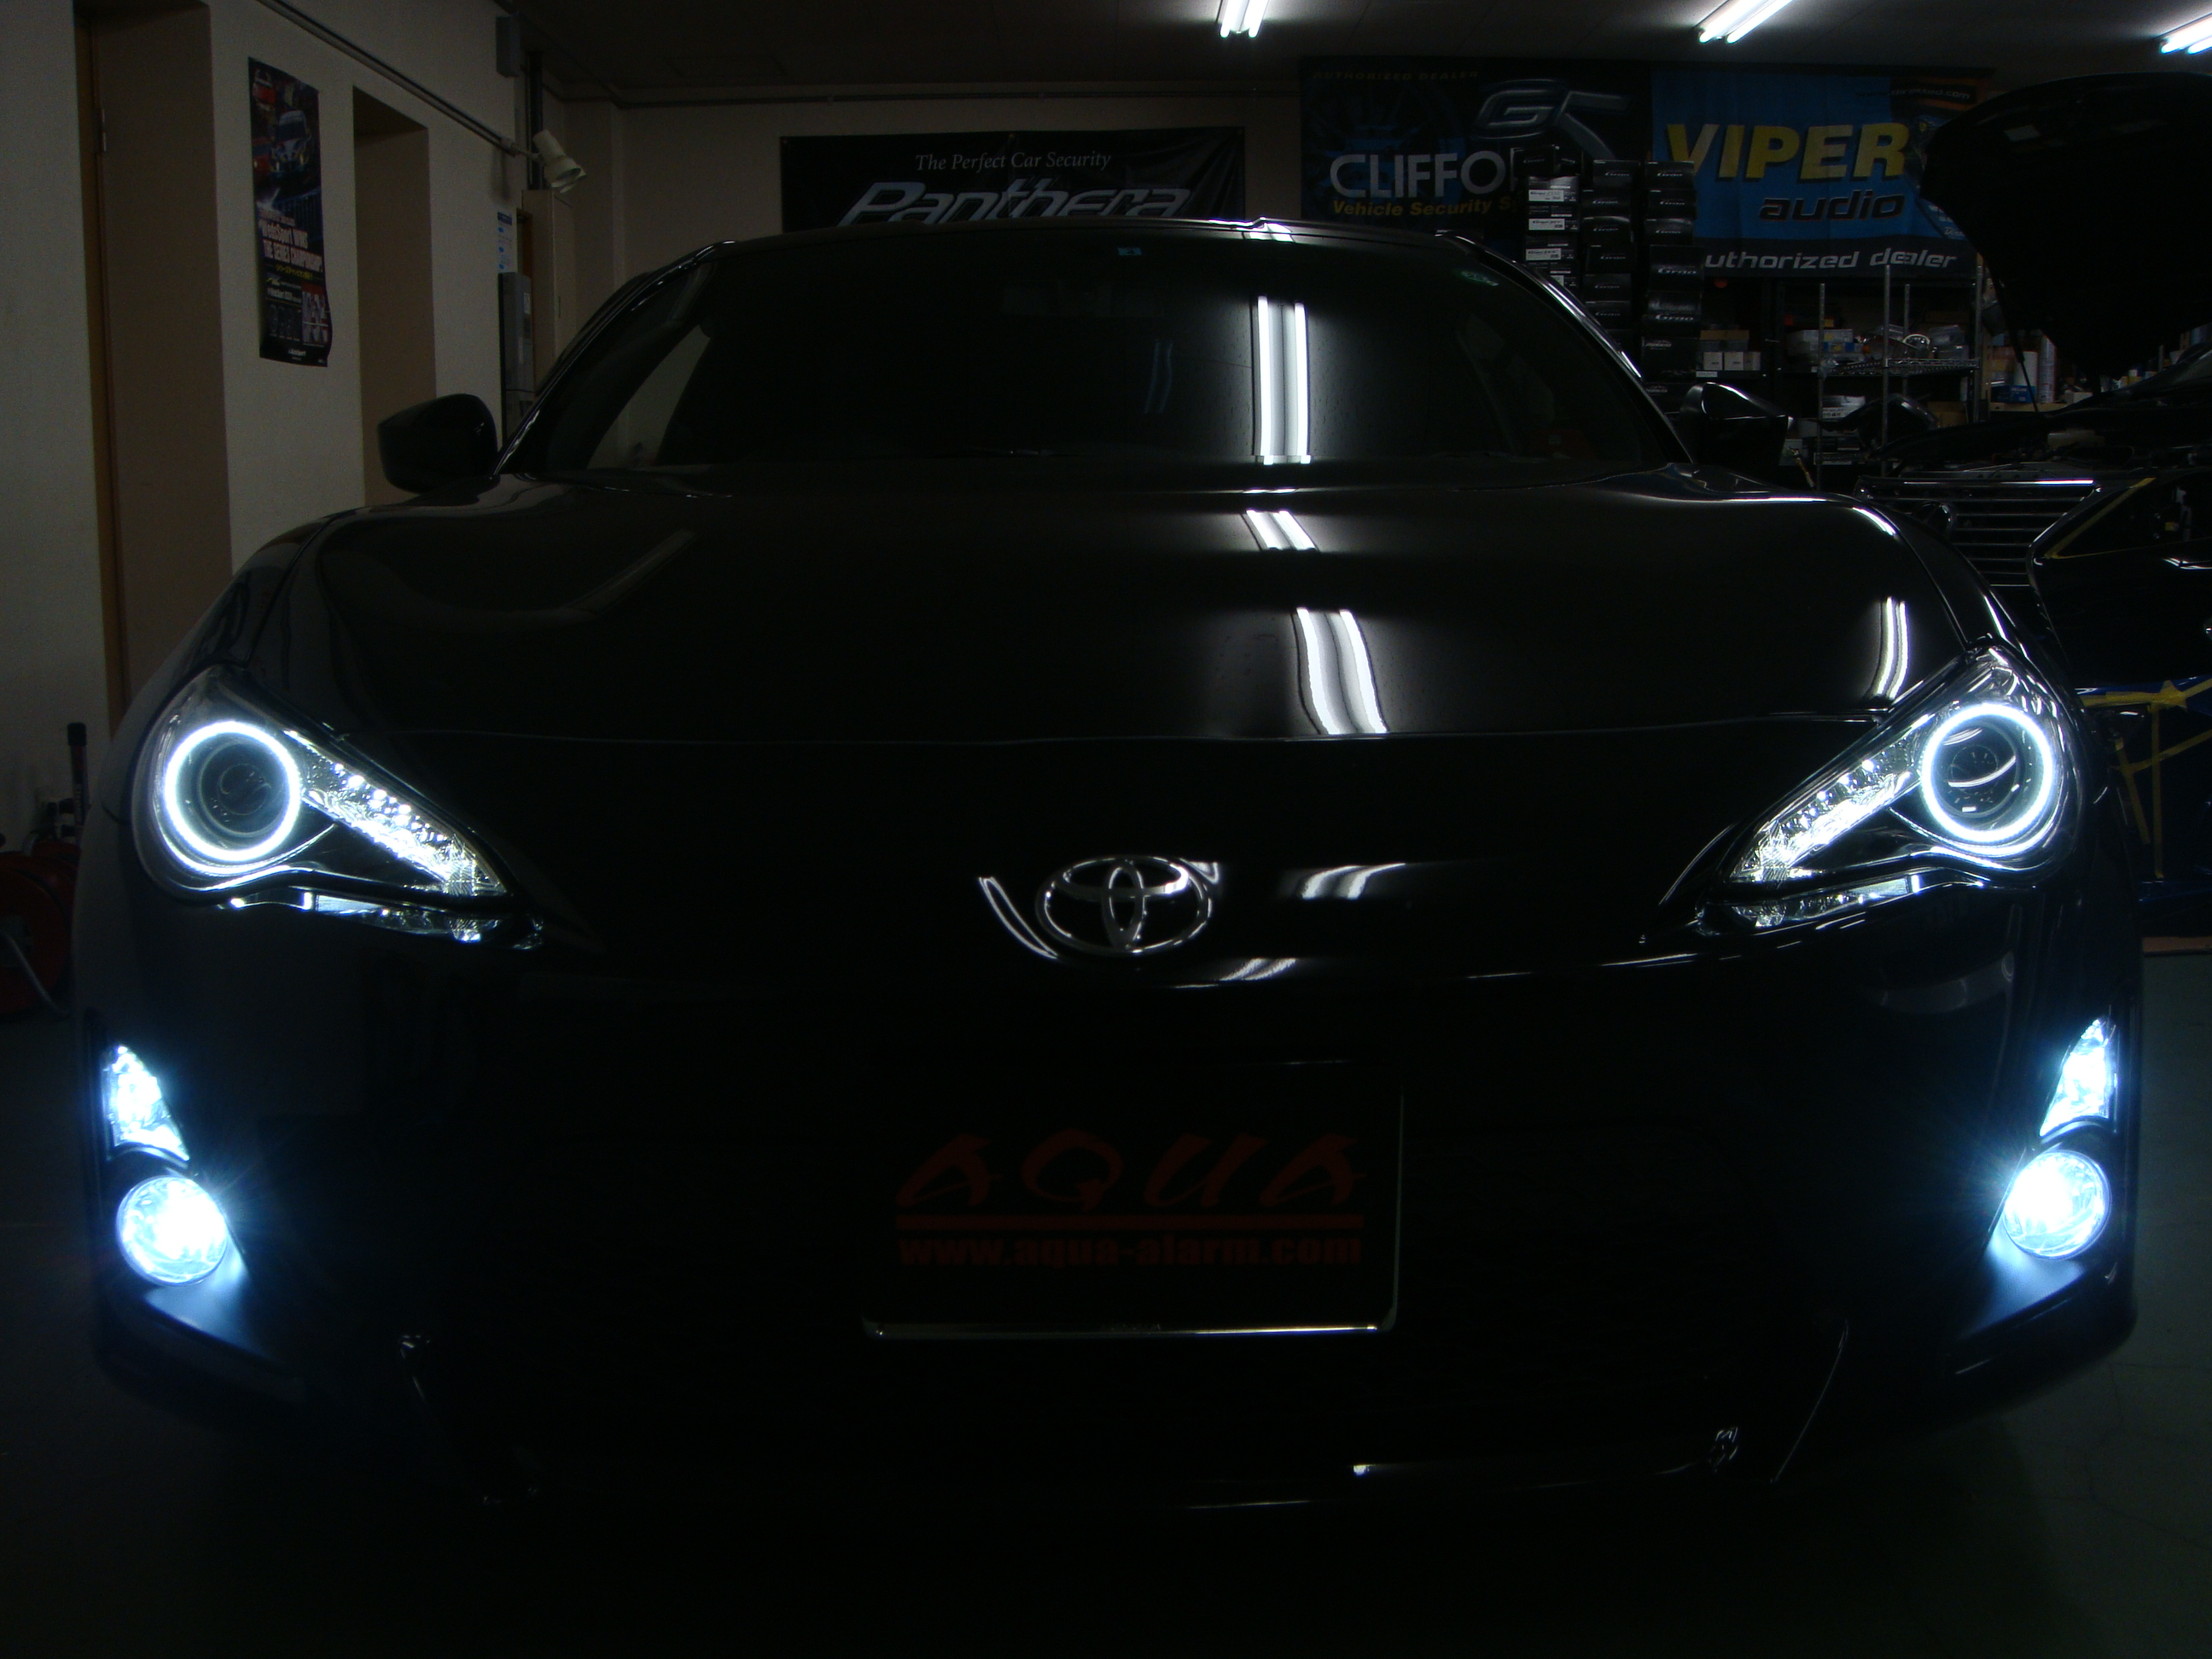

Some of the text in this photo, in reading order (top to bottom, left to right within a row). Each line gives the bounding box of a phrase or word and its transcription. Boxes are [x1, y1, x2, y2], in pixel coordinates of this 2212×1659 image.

[916, 149, 1112, 174] The Perfect Car Security
[1666, 123, 1910, 179] VIPER
[1329, 148, 1521, 200] CLIFFO
[1332, 198, 1404, 216] Vehicle
[1409, 197, 1493, 216] Security
[1758, 189, 1906, 222] audio
[1703, 247, 1958, 271] uthorized dealer
[894, 1127, 1368, 1214] AQUA
[897, 1234, 1363, 1270] www.aqua-alarm.com
